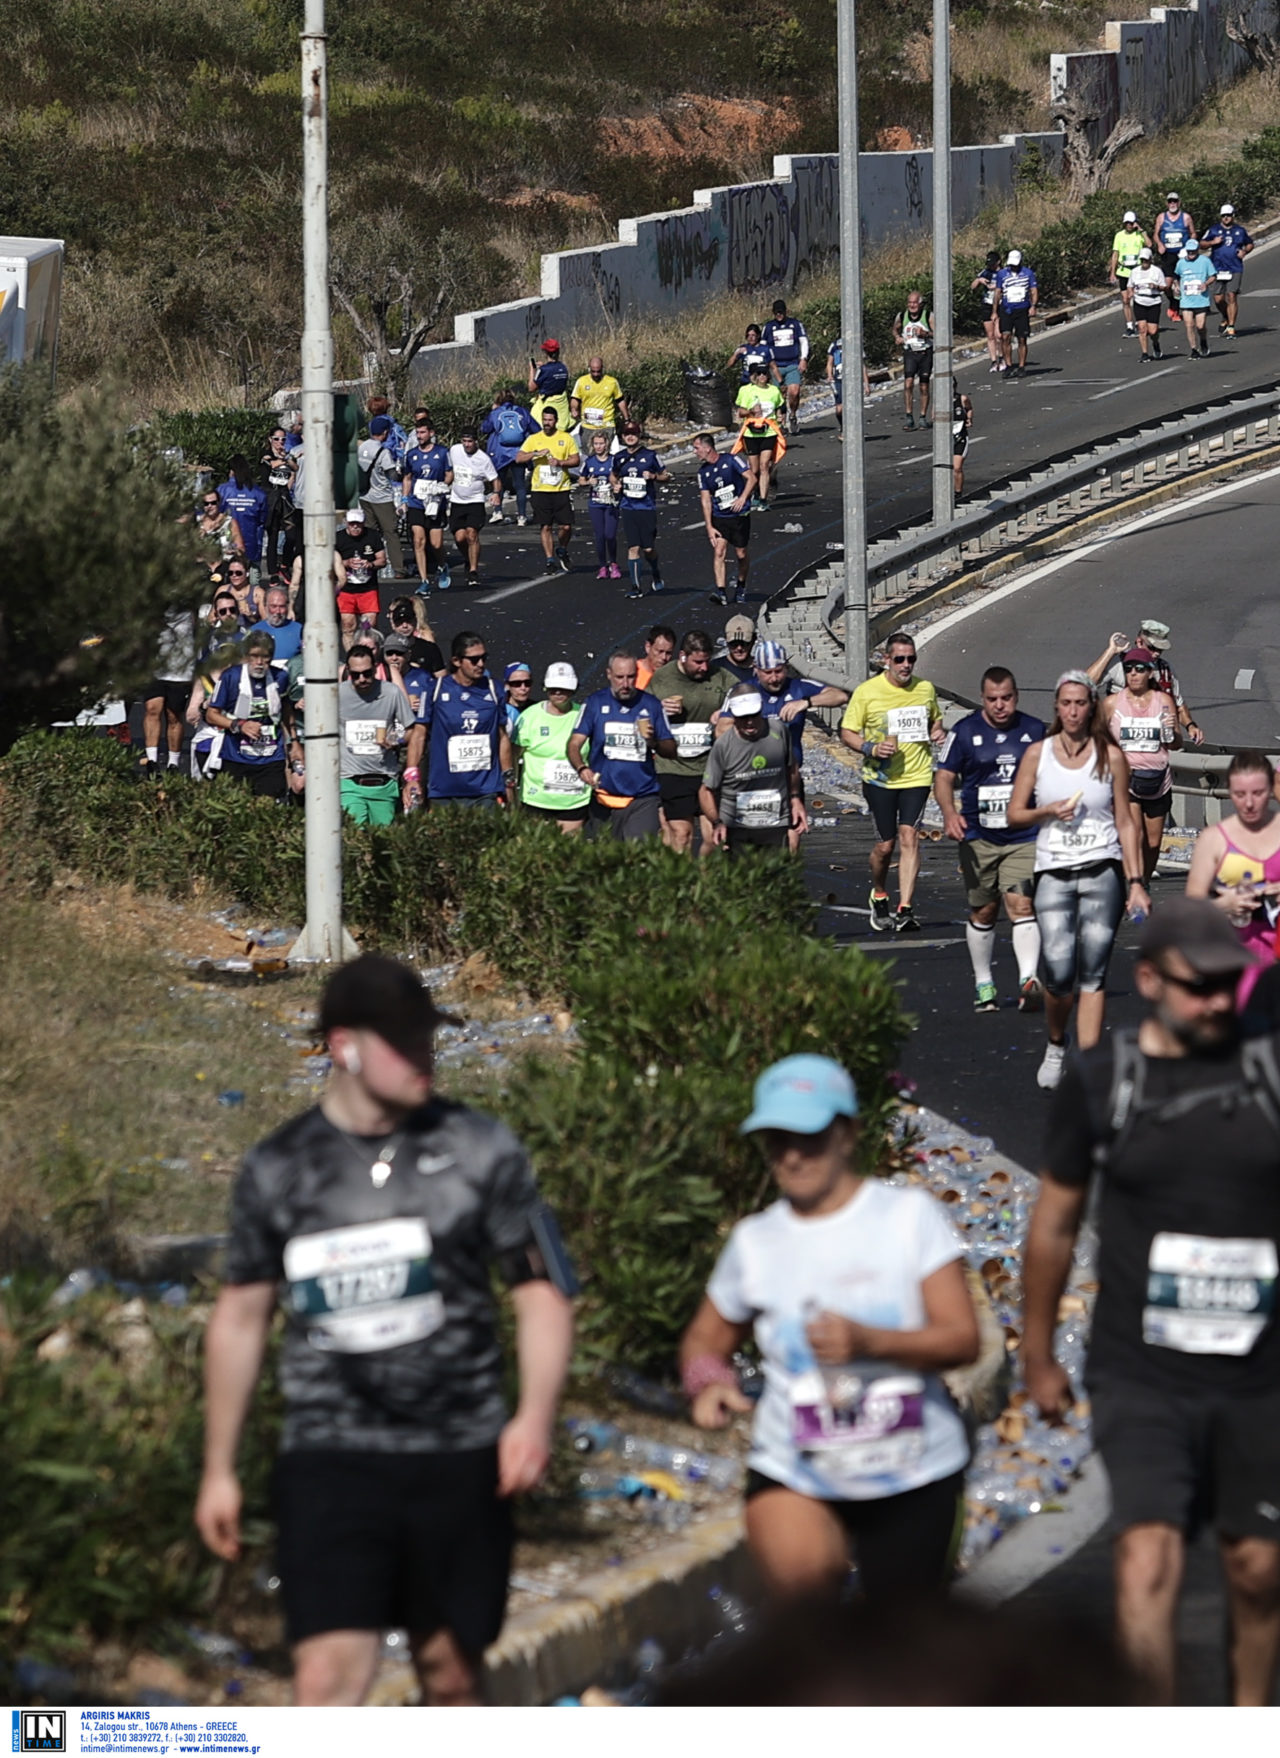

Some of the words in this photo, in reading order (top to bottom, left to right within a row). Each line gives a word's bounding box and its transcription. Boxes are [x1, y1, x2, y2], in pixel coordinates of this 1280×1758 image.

[1128, 728, 1153, 738] 17511
[458, 747, 484, 757] 15875
[1062, 834, 1097, 847] 15877
